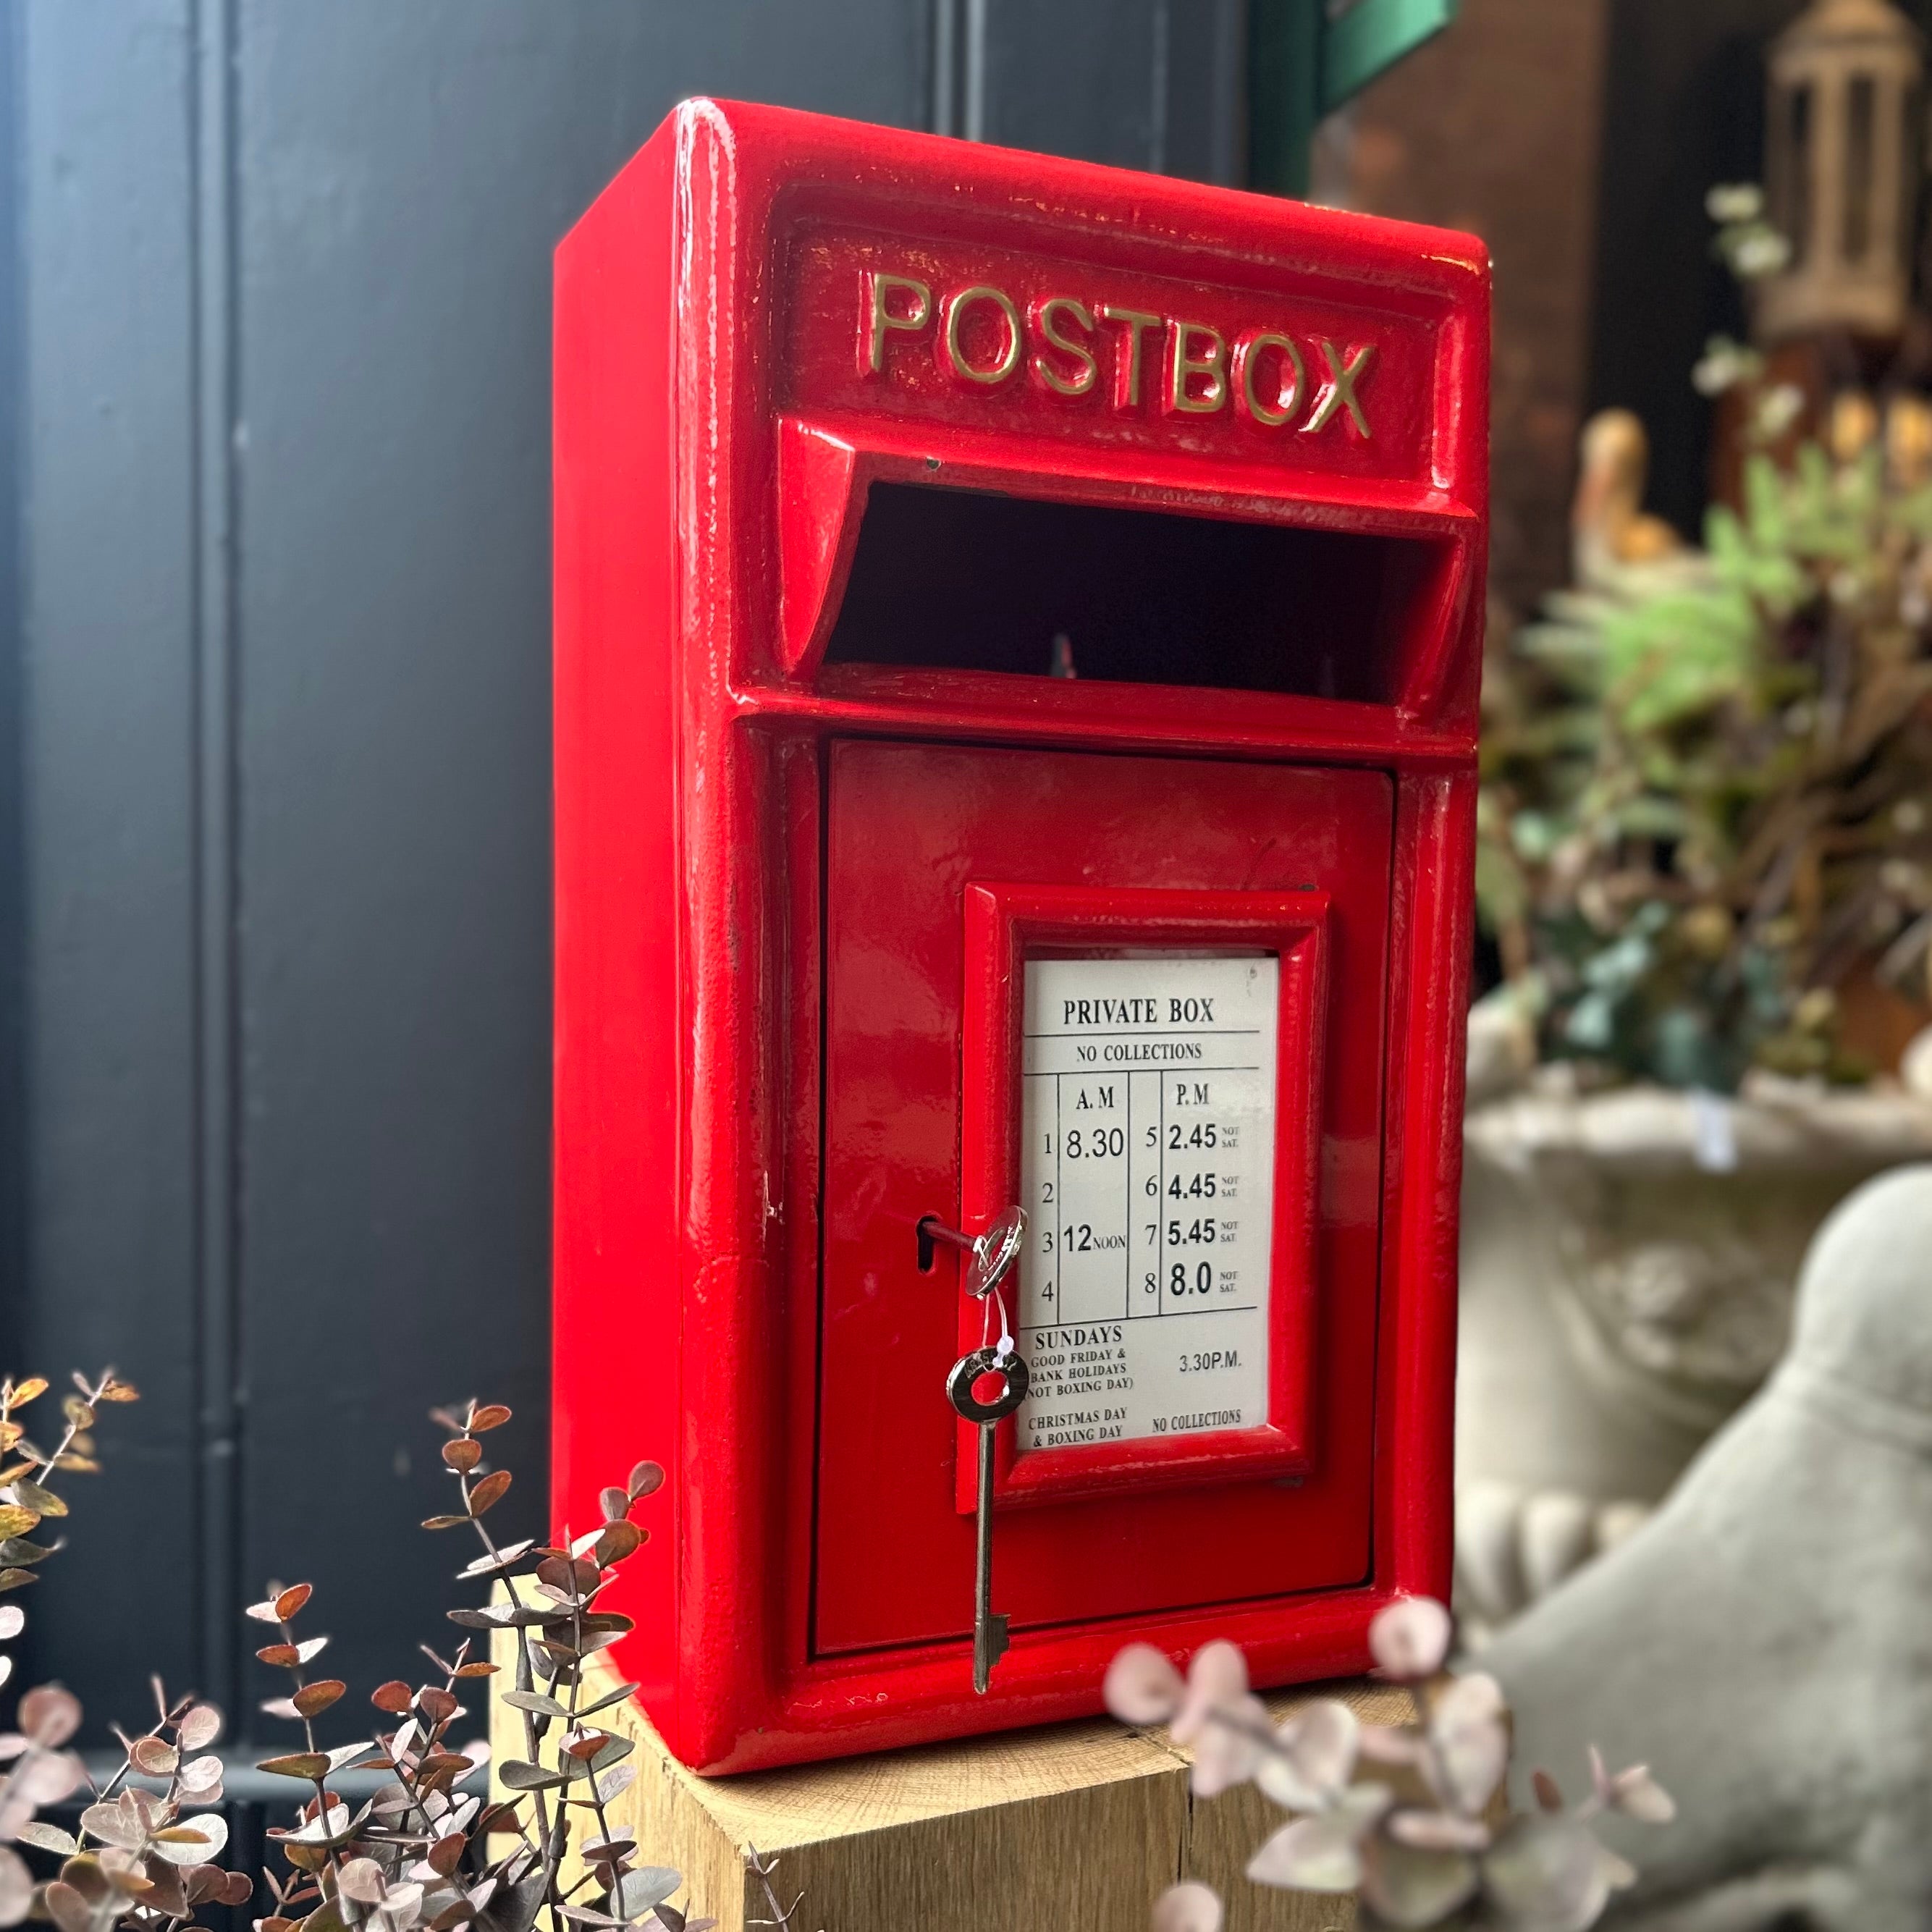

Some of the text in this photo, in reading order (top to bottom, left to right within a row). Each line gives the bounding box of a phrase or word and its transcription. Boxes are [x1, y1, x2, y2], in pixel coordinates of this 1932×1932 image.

[869, 272, 1375, 439] POSTBOX
[1063, 998, 1215, 1024] PRIVATE BOX
[1077, 1043, 1202, 1061] NO COLLECTIONS
[1076, 1087, 1114, 1109] A.M
[1044, 1128, 1123, 1159] 1 8.30
[1145, 1123, 1239, 1150] 5 2.45 NOT
[1042, 1183, 1054, 1203] 2
[1145, 1174, 1157, 1196] 6
[1168, 1173, 1215, 1199] 4.45
[1042, 1232, 1053, 1252] 3
[1144, 1218, 1239, 1246] 7 5.45 NOT
[1144, 1261, 1238, 1296] 8 8.0 NOT
[1042, 1281, 1054, 1302] 4
[1035, 1325, 1122, 1349] SUNDAYS
[1031, 1354, 1065, 1367] GOOD
[1071, 1349, 1113, 1363] FRIDAY
[1118, 1348, 1126, 1358] &
[1031, 1363, 1126, 1383] BANK HOLIDAYS
[1025, 1377, 1134, 1400] NOT BOXING DAY)
[1029, 1407, 1127, 1430] CHRISTMAS DAY
[1152, 1409, 1241, 1433] NO COLLECTIONS
[1034, 1425, 1123, 1447] & BOXING DAY
